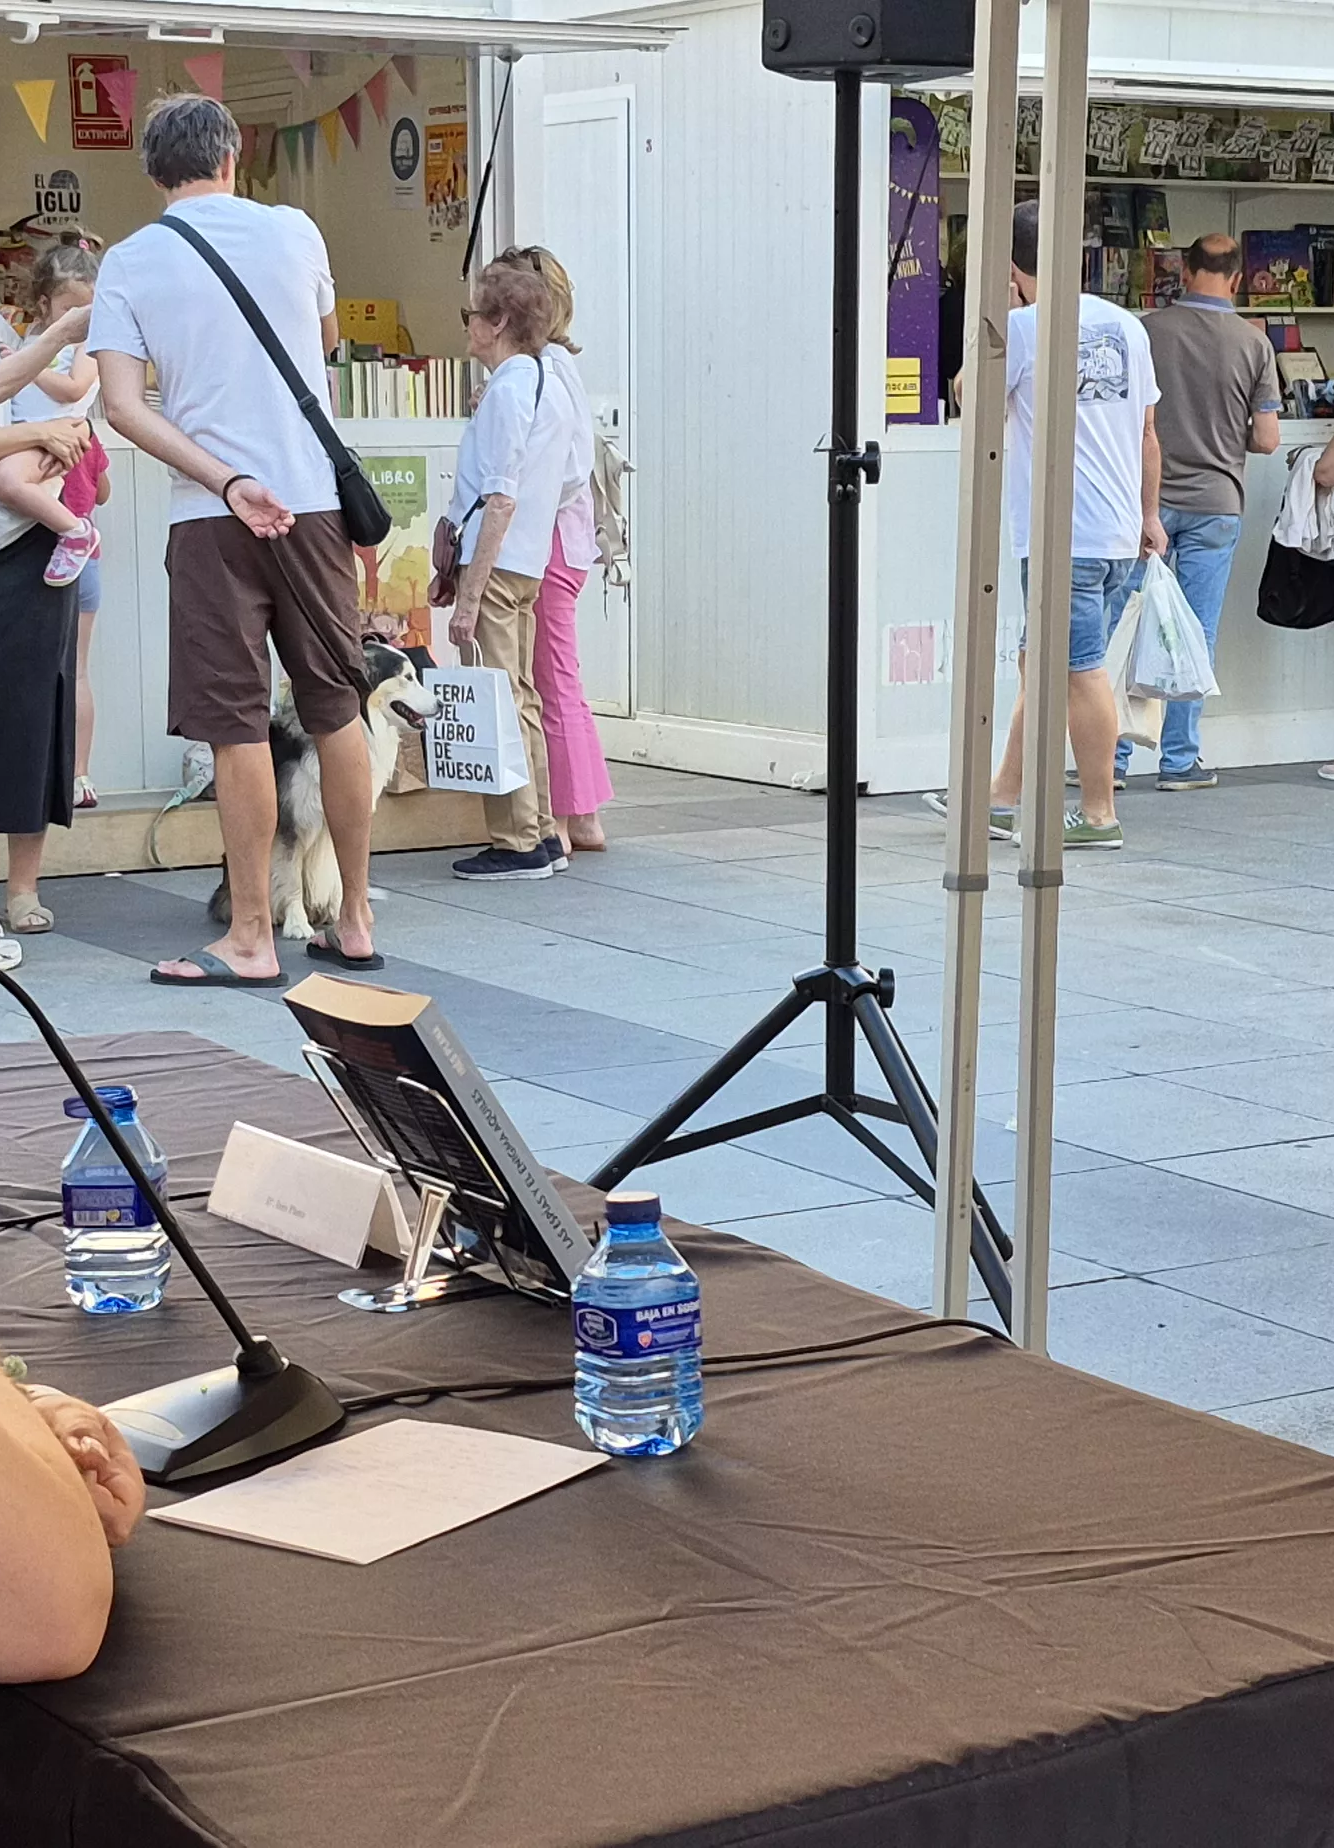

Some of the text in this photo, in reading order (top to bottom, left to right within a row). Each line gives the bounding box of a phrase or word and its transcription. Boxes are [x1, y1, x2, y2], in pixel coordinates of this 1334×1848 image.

[77, 129, 127, 140] EXTINTOR
[34, 173, 46, 189] EL
[371, 470, 415, 485] LIBRO
[433, 684, 475, 703] FERIA
[433, 722, 476, 743] LIBRO
[434, 742, 452, 760] DE
[435, 760, 495, 783] HUESCA
[470, 1088, 575, 1249] LAS ESPÍAS Y EL ENIGMA AQUILES
[635, 1309, 662, 1322] BAJA
[662, 1304, 676, 1316] EN
